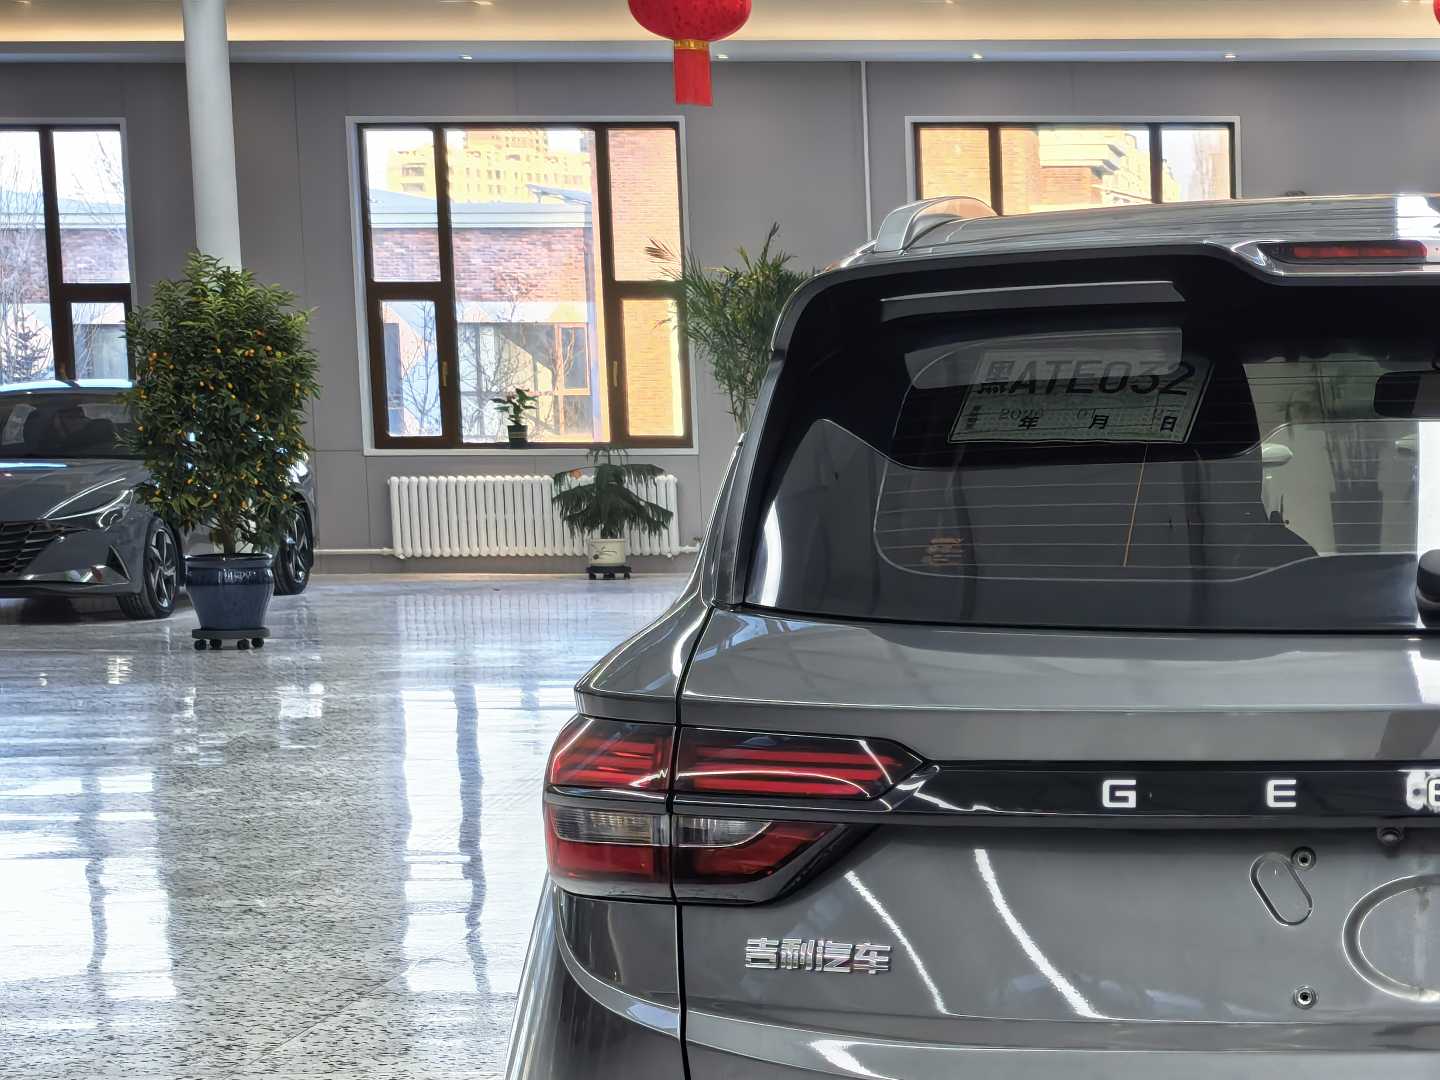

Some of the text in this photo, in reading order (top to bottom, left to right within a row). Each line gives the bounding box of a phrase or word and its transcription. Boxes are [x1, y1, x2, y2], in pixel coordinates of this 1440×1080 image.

[1088, 414, 1110, 430] 月
[1160, 415, 1178, 432] 日
[745, 937, 891, 975] 吉利汽车
